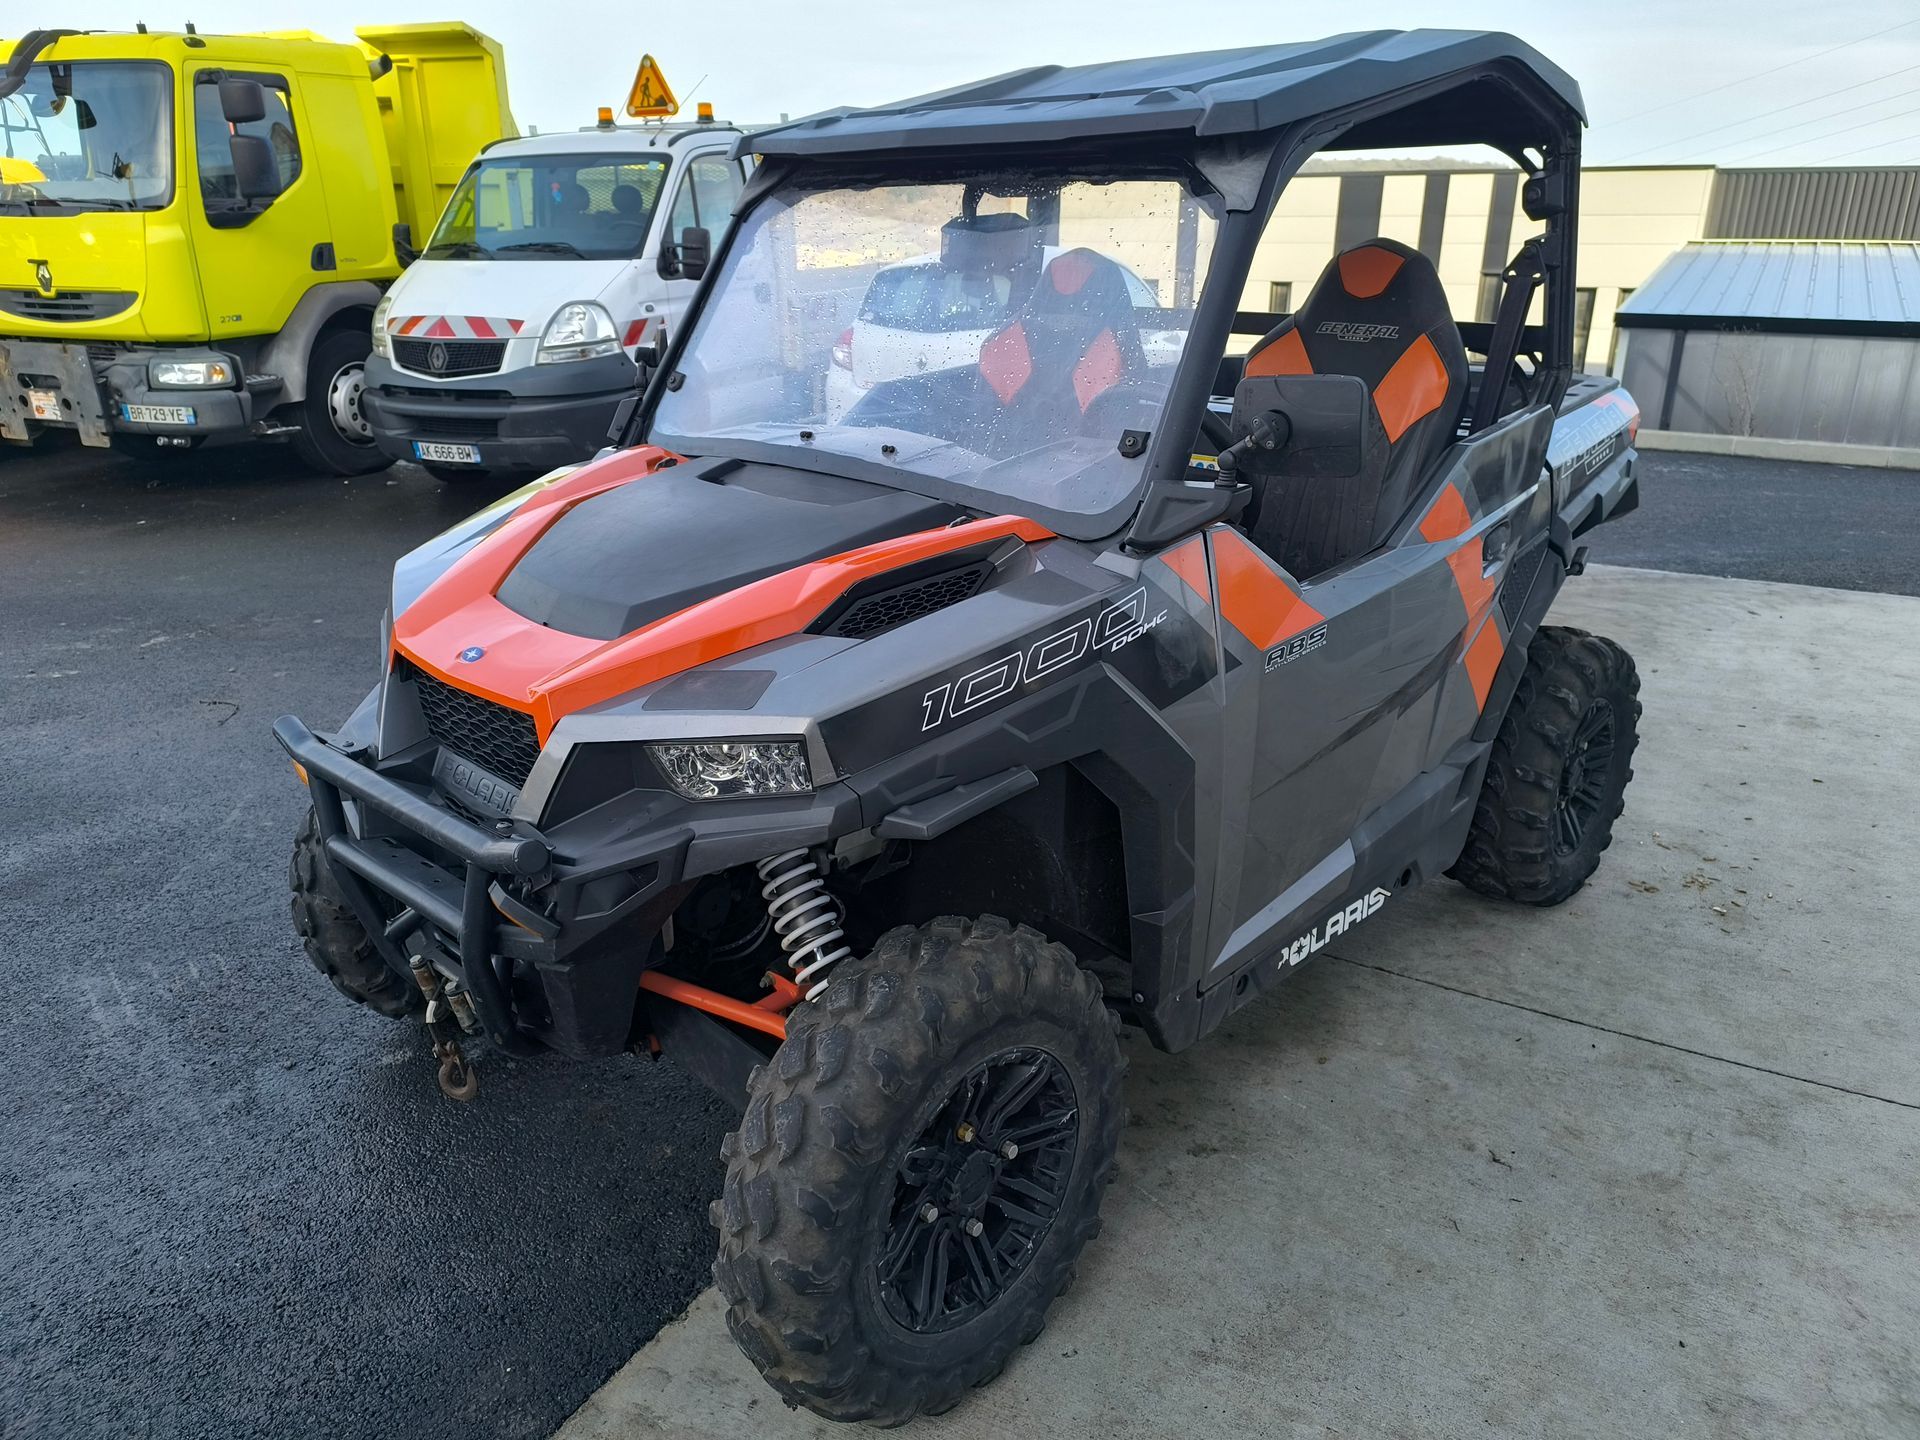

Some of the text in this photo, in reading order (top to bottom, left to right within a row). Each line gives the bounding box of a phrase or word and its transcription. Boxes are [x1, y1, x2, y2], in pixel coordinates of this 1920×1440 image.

[1316, 321, 1399, 339] GENERAL
[1111, 609, 1168, 652] DOHC
[1264, 624, 1328, 669] ABS
[921, 586, 1147, 732] 1000
[1264, 654, 1301, 674] ANTI-LOCK
